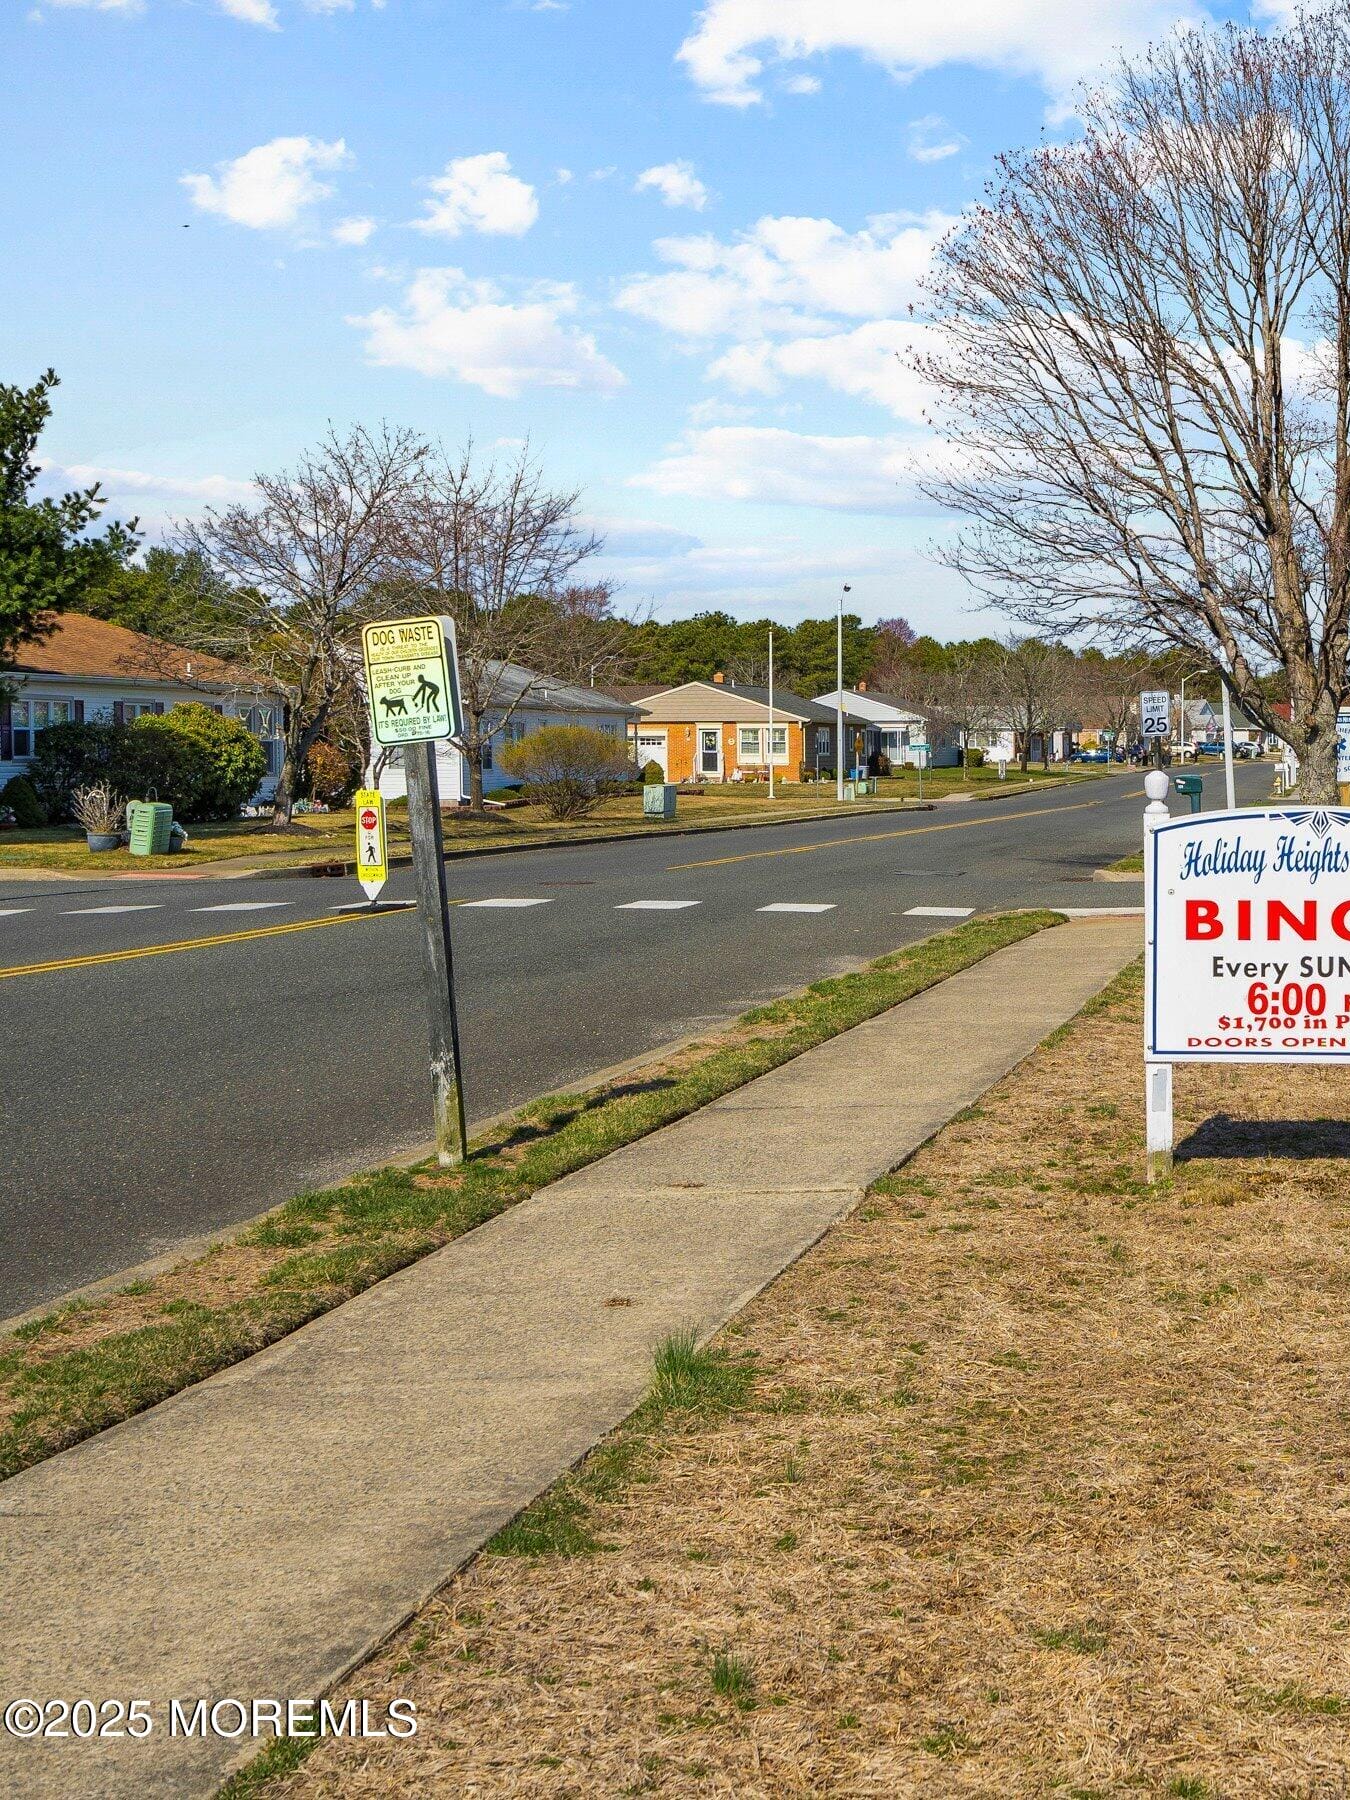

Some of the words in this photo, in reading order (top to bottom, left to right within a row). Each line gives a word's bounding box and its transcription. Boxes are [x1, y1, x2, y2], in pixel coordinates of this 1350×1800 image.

[372, 630, 395, 646] DOG
[399, 625, 433, 642] WASTE
[390, 716, 420, 727] REQUIRED
[1144, 717, 1167, 733] 25
[361, 816, 376, 824] STOP
[1180, 839, 1267, 884] Holiday
[1273, 833, 1349, 884] Heights
[1213, 957, 1290, 984] Every
[1248, 980, 1326, 1015] 6:00
[1218, 1015, 1296, 1032] $1,700
[1304, 1015, 1327, 1029] in
[1188, 1038, 1272, 1047] DOORS
[1282, 1038, 1345, 1047] OPEN
